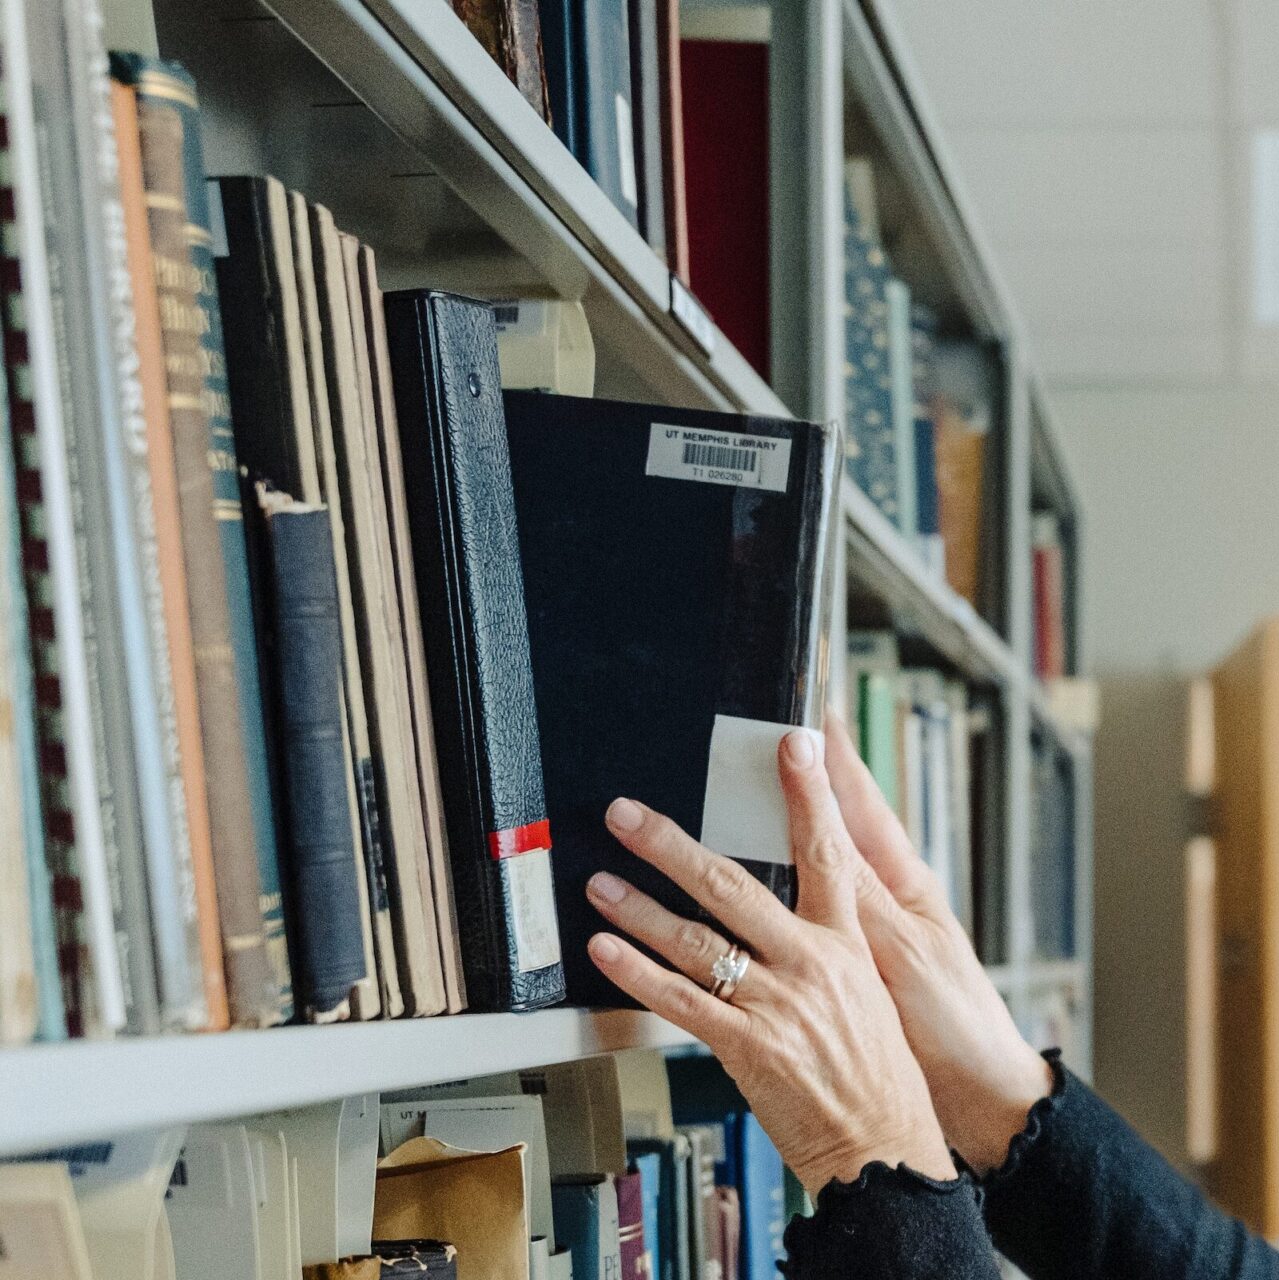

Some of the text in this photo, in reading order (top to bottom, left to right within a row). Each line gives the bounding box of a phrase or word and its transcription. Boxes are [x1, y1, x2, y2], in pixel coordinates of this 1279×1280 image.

[665, 430, 778, 451] UT MEMPHIS LIBRARY
[400, 1111, 413, 1120] UT
